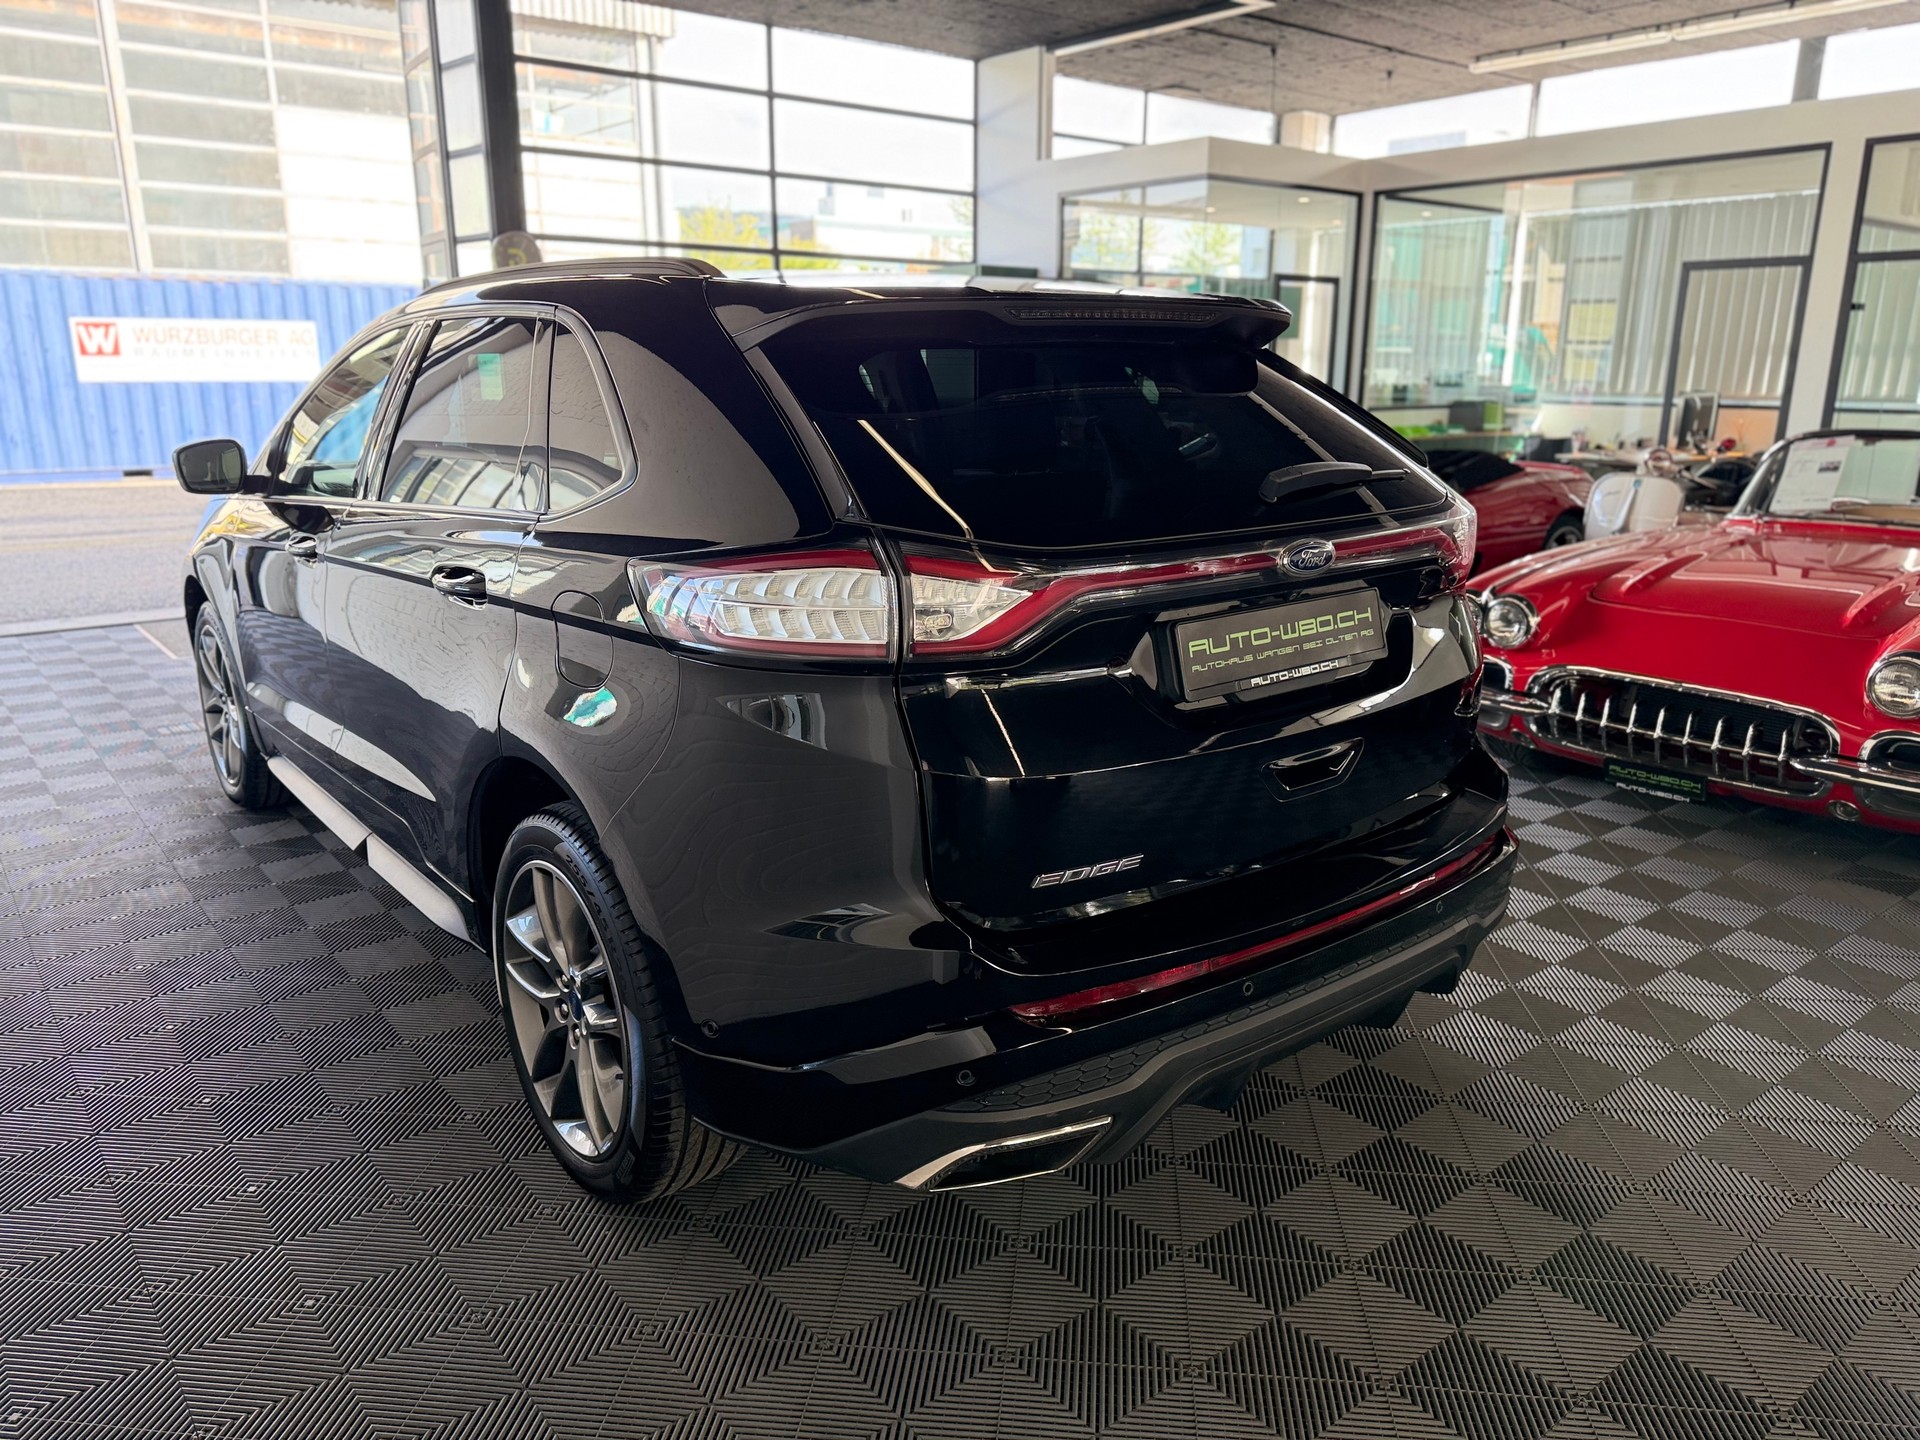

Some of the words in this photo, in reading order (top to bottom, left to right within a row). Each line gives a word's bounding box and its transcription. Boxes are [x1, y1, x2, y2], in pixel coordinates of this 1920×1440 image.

[289, 328, 314, 346] AG
[1298, 548, 1327, 568] Ford
[1188, 607, 1372, 658] AUTO-WBO.CH
[1191, 654, 1254, 673] AUTOHAUS
[1257, 645, 1300, 661] WANGEN
[1303, 639, 1323, 650] BEI
[1325, 631, 1359, 645] OLTEN
[1361, 628, 1375, 638] AG
[1251, 660, 1339, 687] AUTO-WBO.CH
[1031, 853, 1145, 889] EDGE
